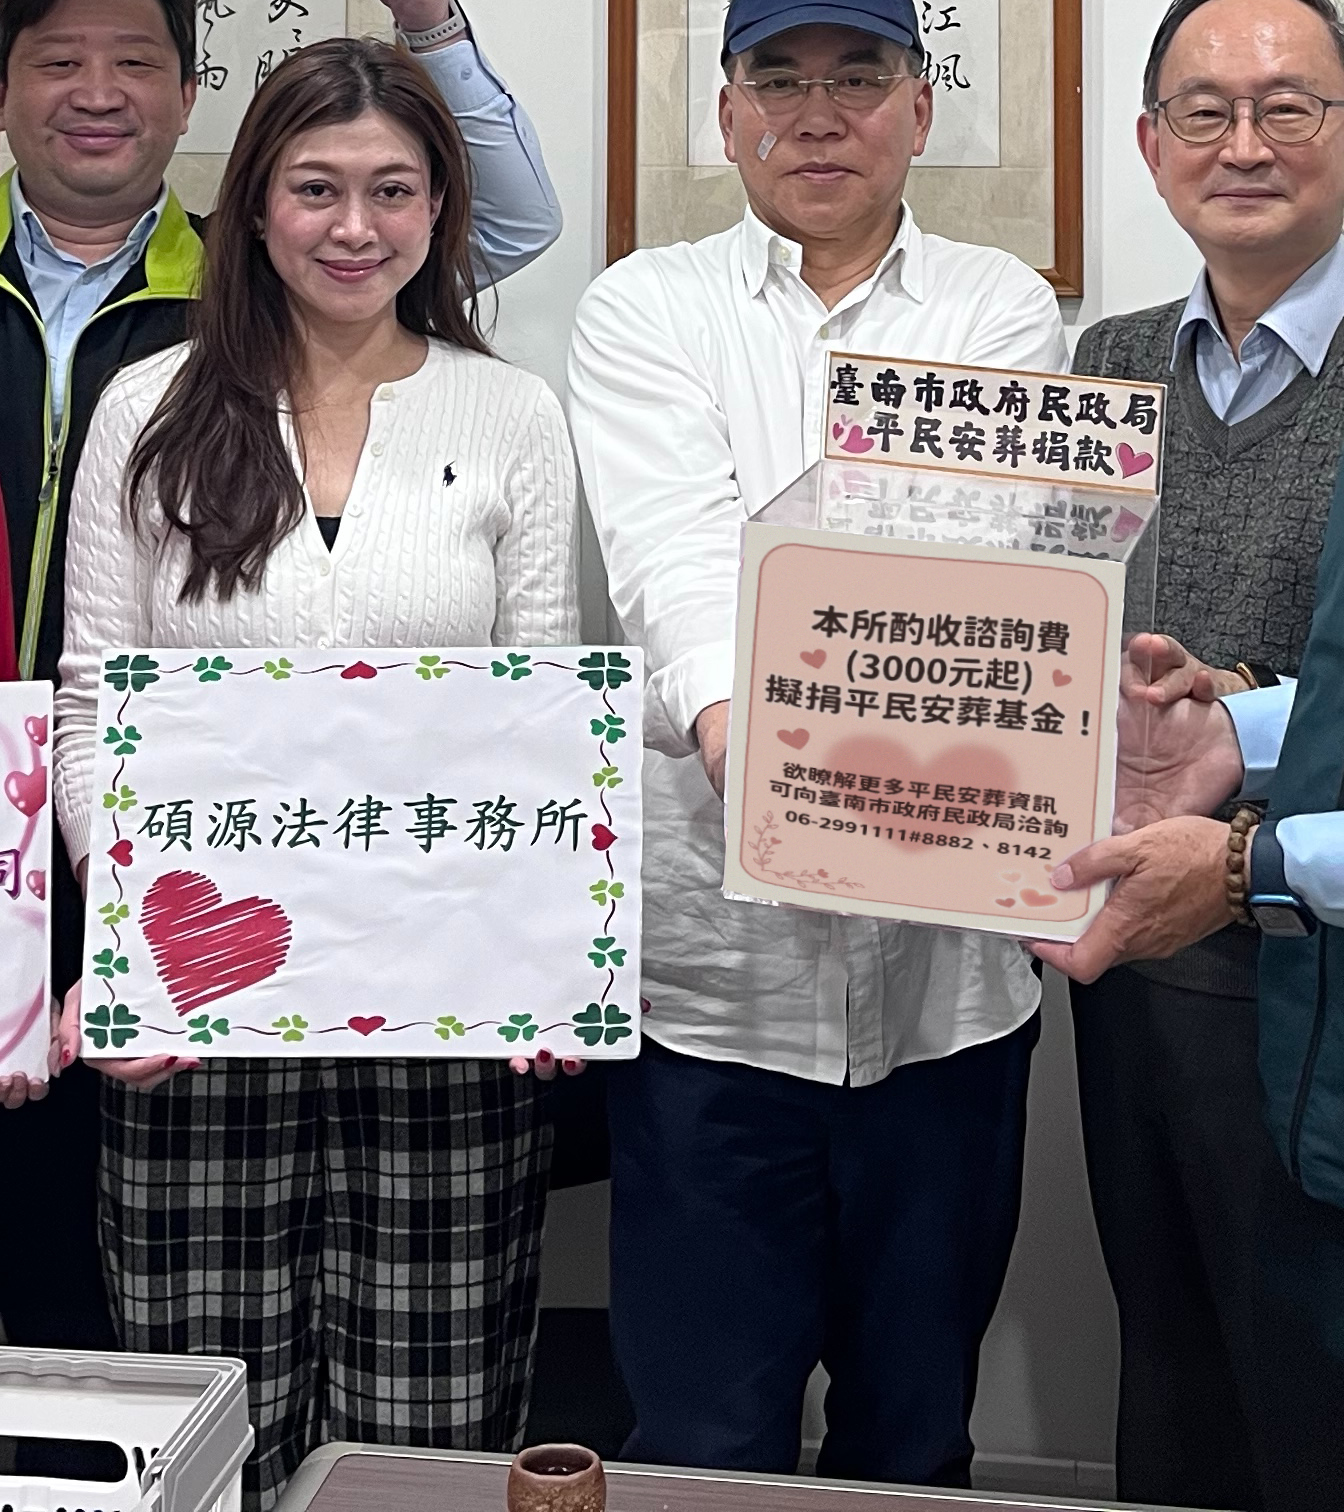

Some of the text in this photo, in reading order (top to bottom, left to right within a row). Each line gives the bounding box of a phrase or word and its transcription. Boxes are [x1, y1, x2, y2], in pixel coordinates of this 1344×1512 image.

[830, 363, 1158, 435] 臺南市政府民政局
[867, 411, 1117, 476] 平民安葬捐款
[812, 605, 1070, 656] 本所酌收諮詢費
[846, 650, 1034, 695] (3000元起)
[769, 779, 1069, 838] 可向臺南市政府民政局洽詢
[783, 762, 1058, 816] 欲瞭解更多平民安葬資訊
[137, 793, 589, 853] 碩源法律事務所
